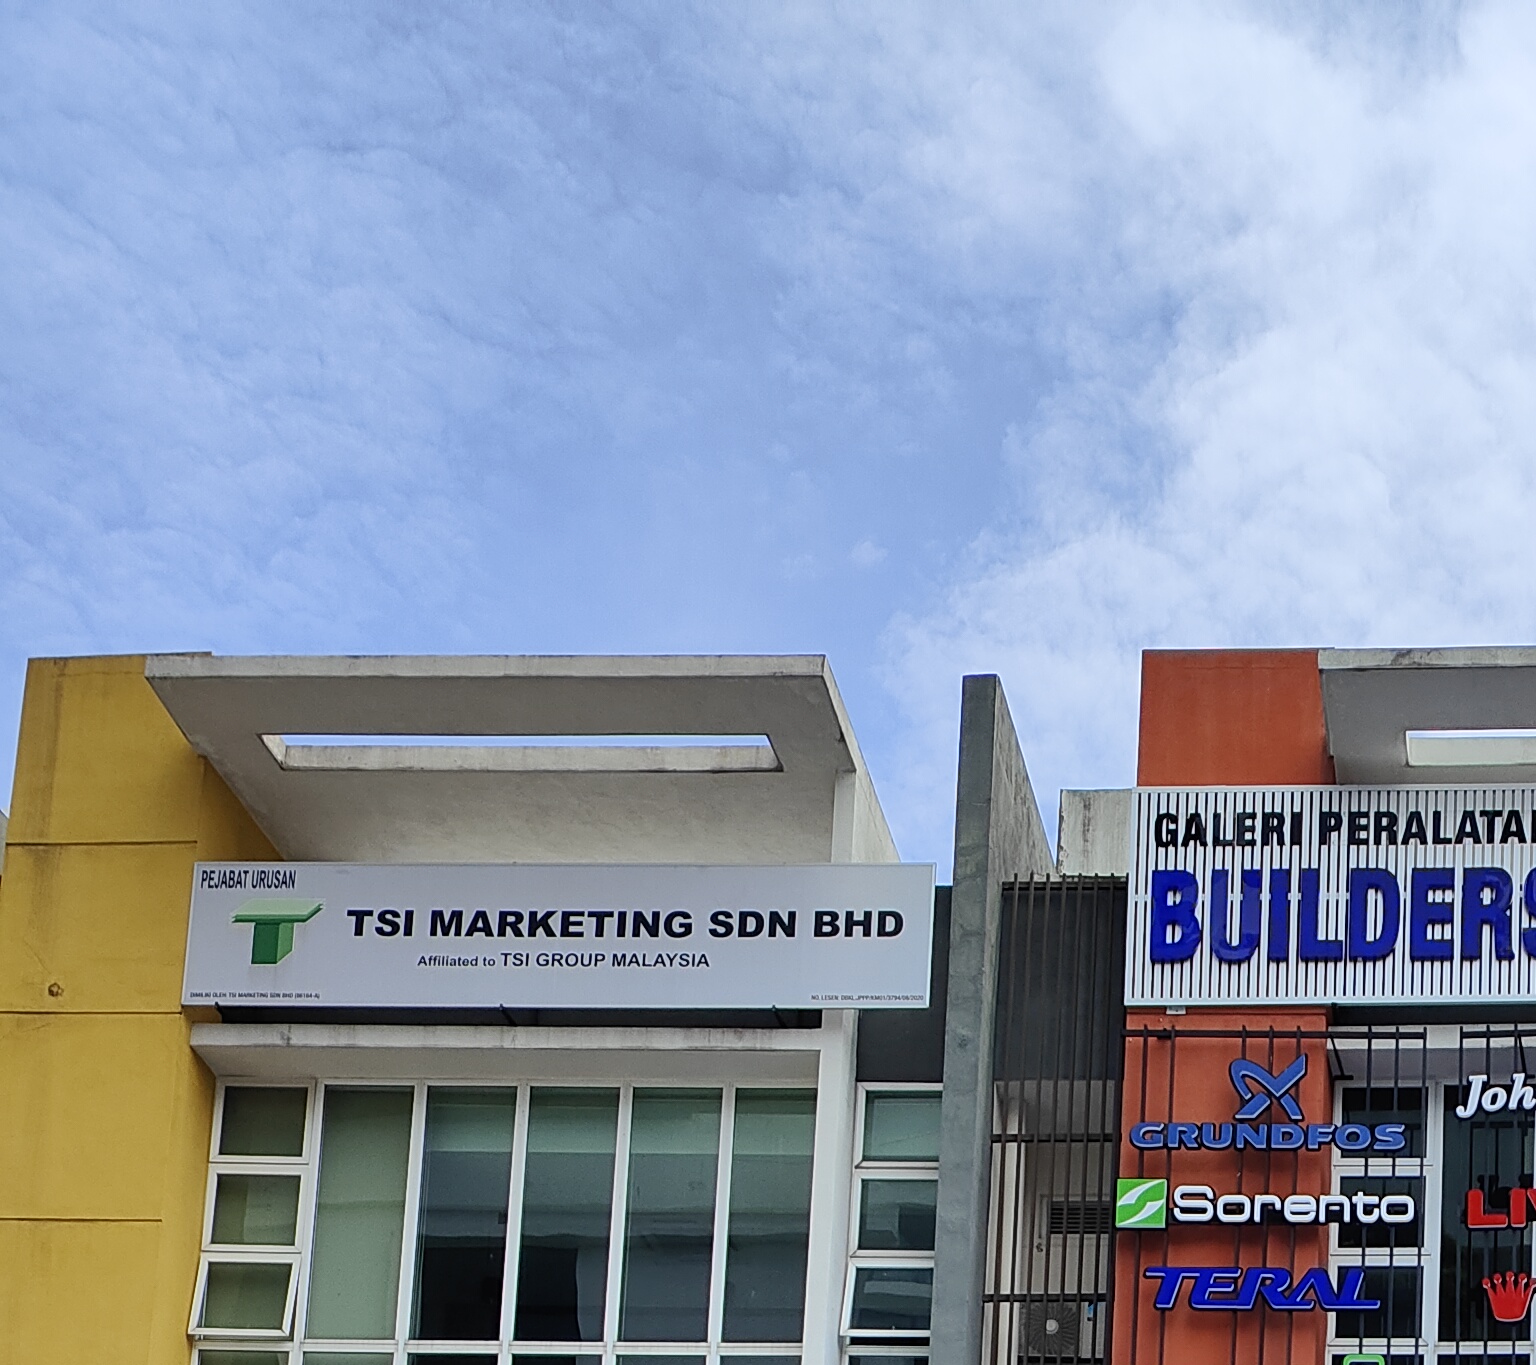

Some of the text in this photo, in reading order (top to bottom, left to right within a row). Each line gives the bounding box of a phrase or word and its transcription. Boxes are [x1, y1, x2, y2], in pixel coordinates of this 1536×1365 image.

[1154, 811, 1301, 848] GALERI
[200, 869, 296, 890] PEJABAT URUSAN
[347, 908, 905, 939] TSI MARKETING SDN BHD
[417, 952, 711, 968] Affiliated to TSI GROUP MALAYSIA
[1129, 1121, 1406, 1151] GRUNDFOS
[1173, 1185, 1416, 1224] Sorento
[1145, 1266, 1381, 1311] TERAL
